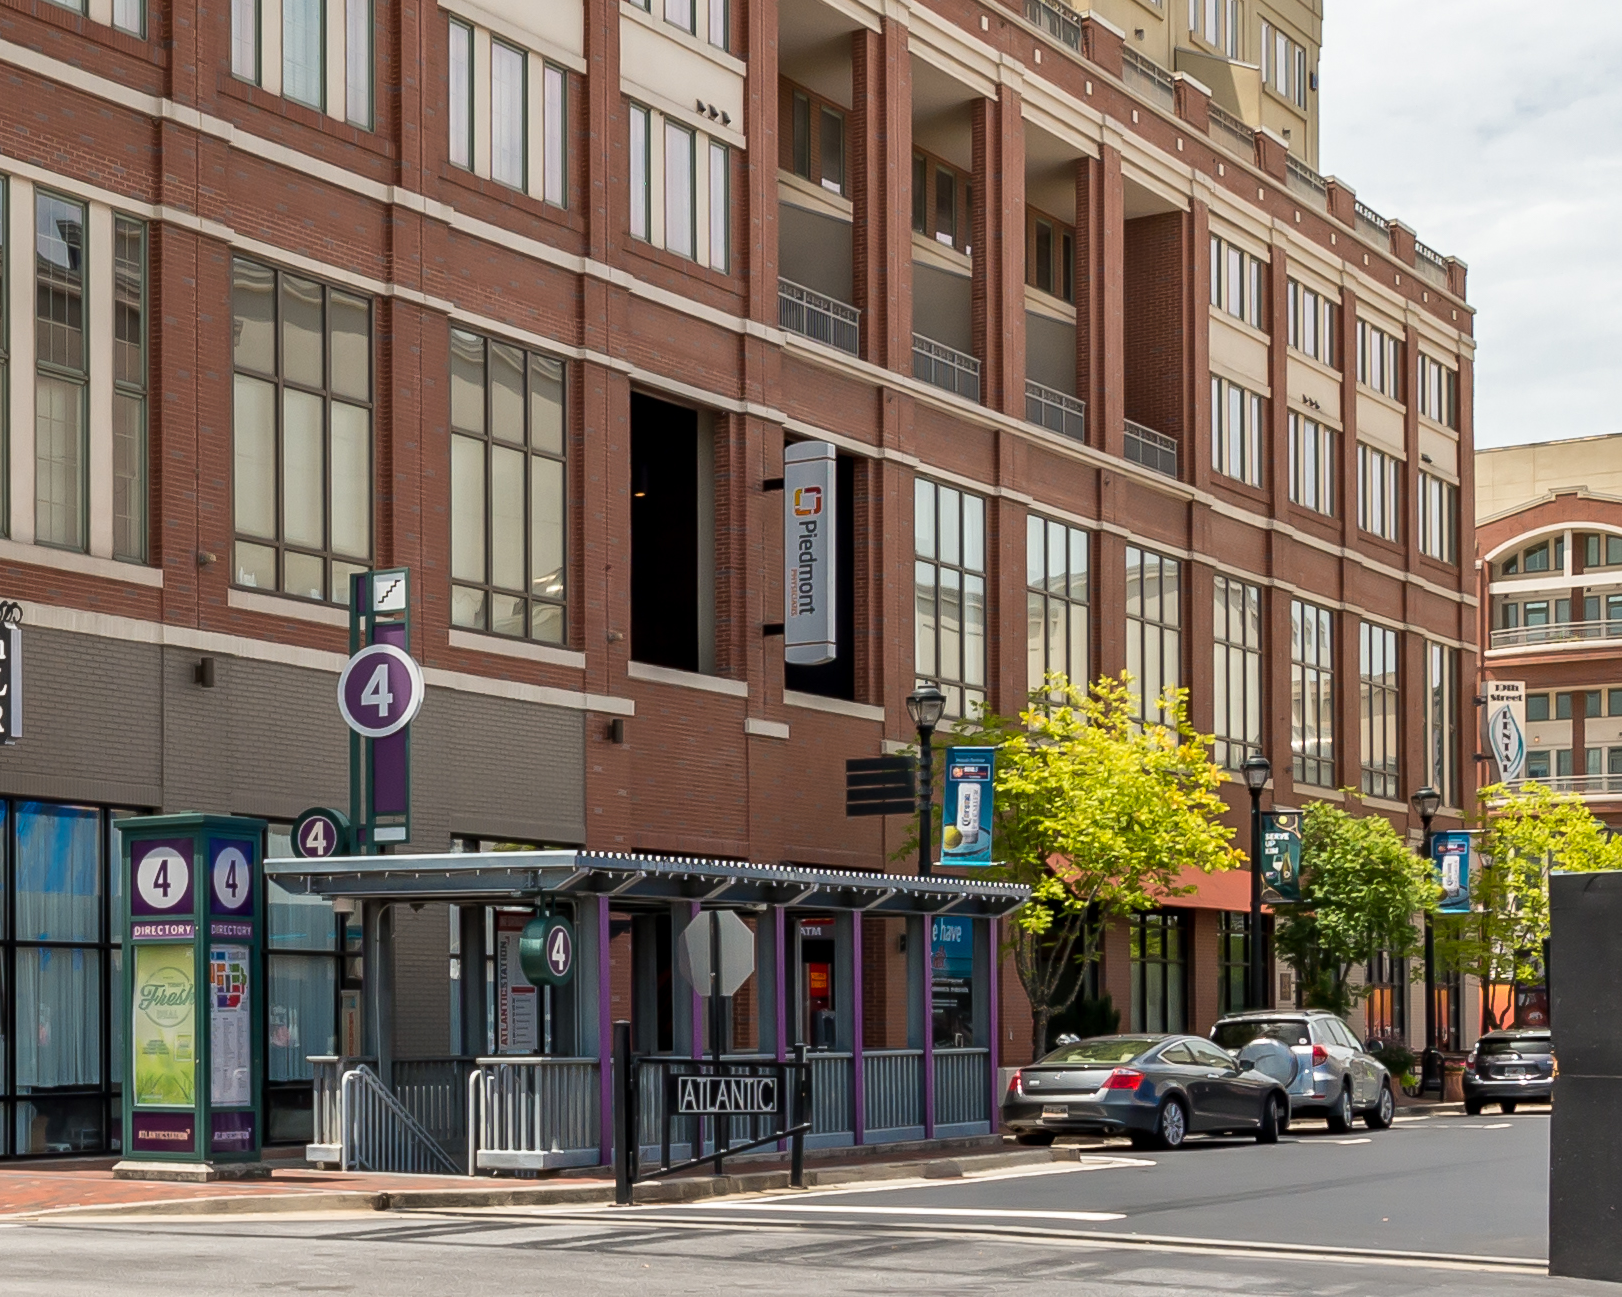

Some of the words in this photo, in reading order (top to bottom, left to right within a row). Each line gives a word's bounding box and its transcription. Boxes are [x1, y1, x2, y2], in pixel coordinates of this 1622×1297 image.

[798, 519, 818, 616] Piedmont
[360, 663, 393, 718] 4
[1490, 693, 1523, 702] Street
[306, 821, 327, 856] 4
[153, 859, 171, 898] 4
[225, 859, 238, 899] 4
[134, 924, 192, 936] DIRECTORY
[211, 924, 252, 937] DIRECTORY
[940, 917, 962, 943] have
[551, 931, 566, 971] 4
[138, 984, 196, 1011] Fresh
[681, 1079, 774, 1111] ATLANTIC
